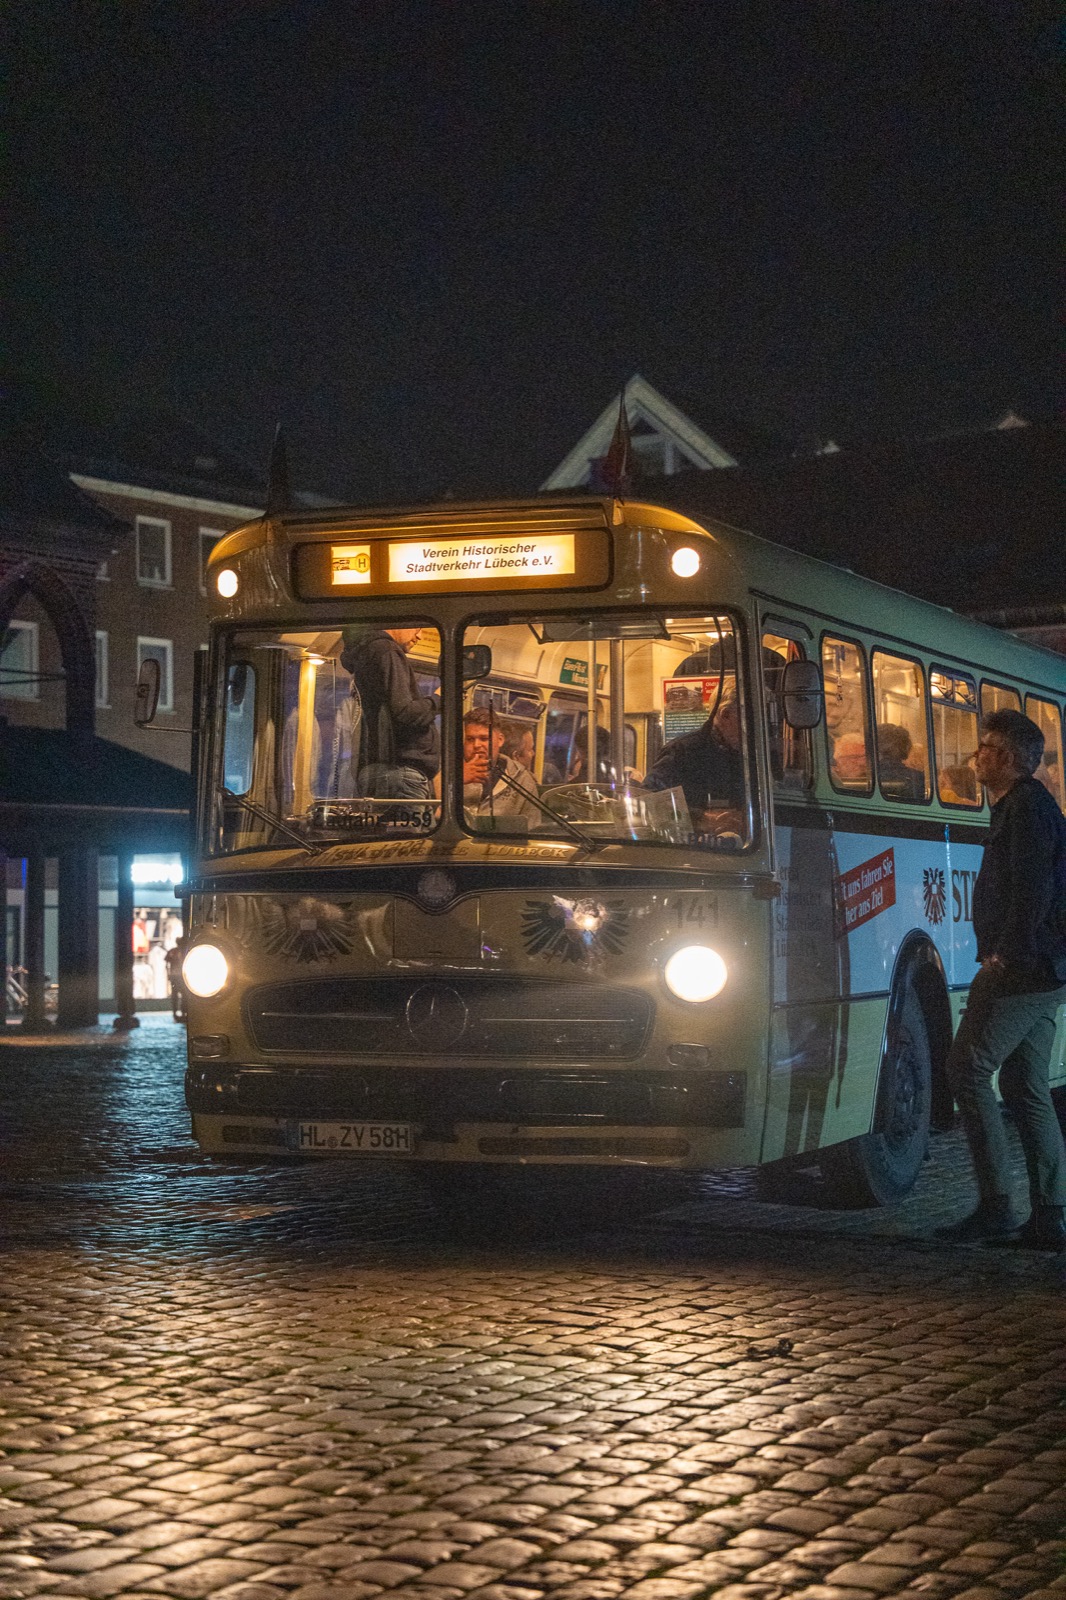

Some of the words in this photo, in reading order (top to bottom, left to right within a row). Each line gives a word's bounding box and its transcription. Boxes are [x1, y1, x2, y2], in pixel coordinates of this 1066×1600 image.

[422, 547, 459, 558] Verein
[462, 543, 536, 556] Historischer
[406, 560, 482, 573] Stadtverkehr
[484, 557, 529, 569] Lübeck
[532, 555, 553, 566] e.V.
[392, 811, 432, 828] 1959
[861, 866, 882, 891] fahren
[882, 856, 893, 878] Sie
[871, 886, 884, 911] Ziel
[672, 896, 719, 929] 141
[300, 1125, 326, 1147] HL
[370, 1126, 409, 1149] 58H
